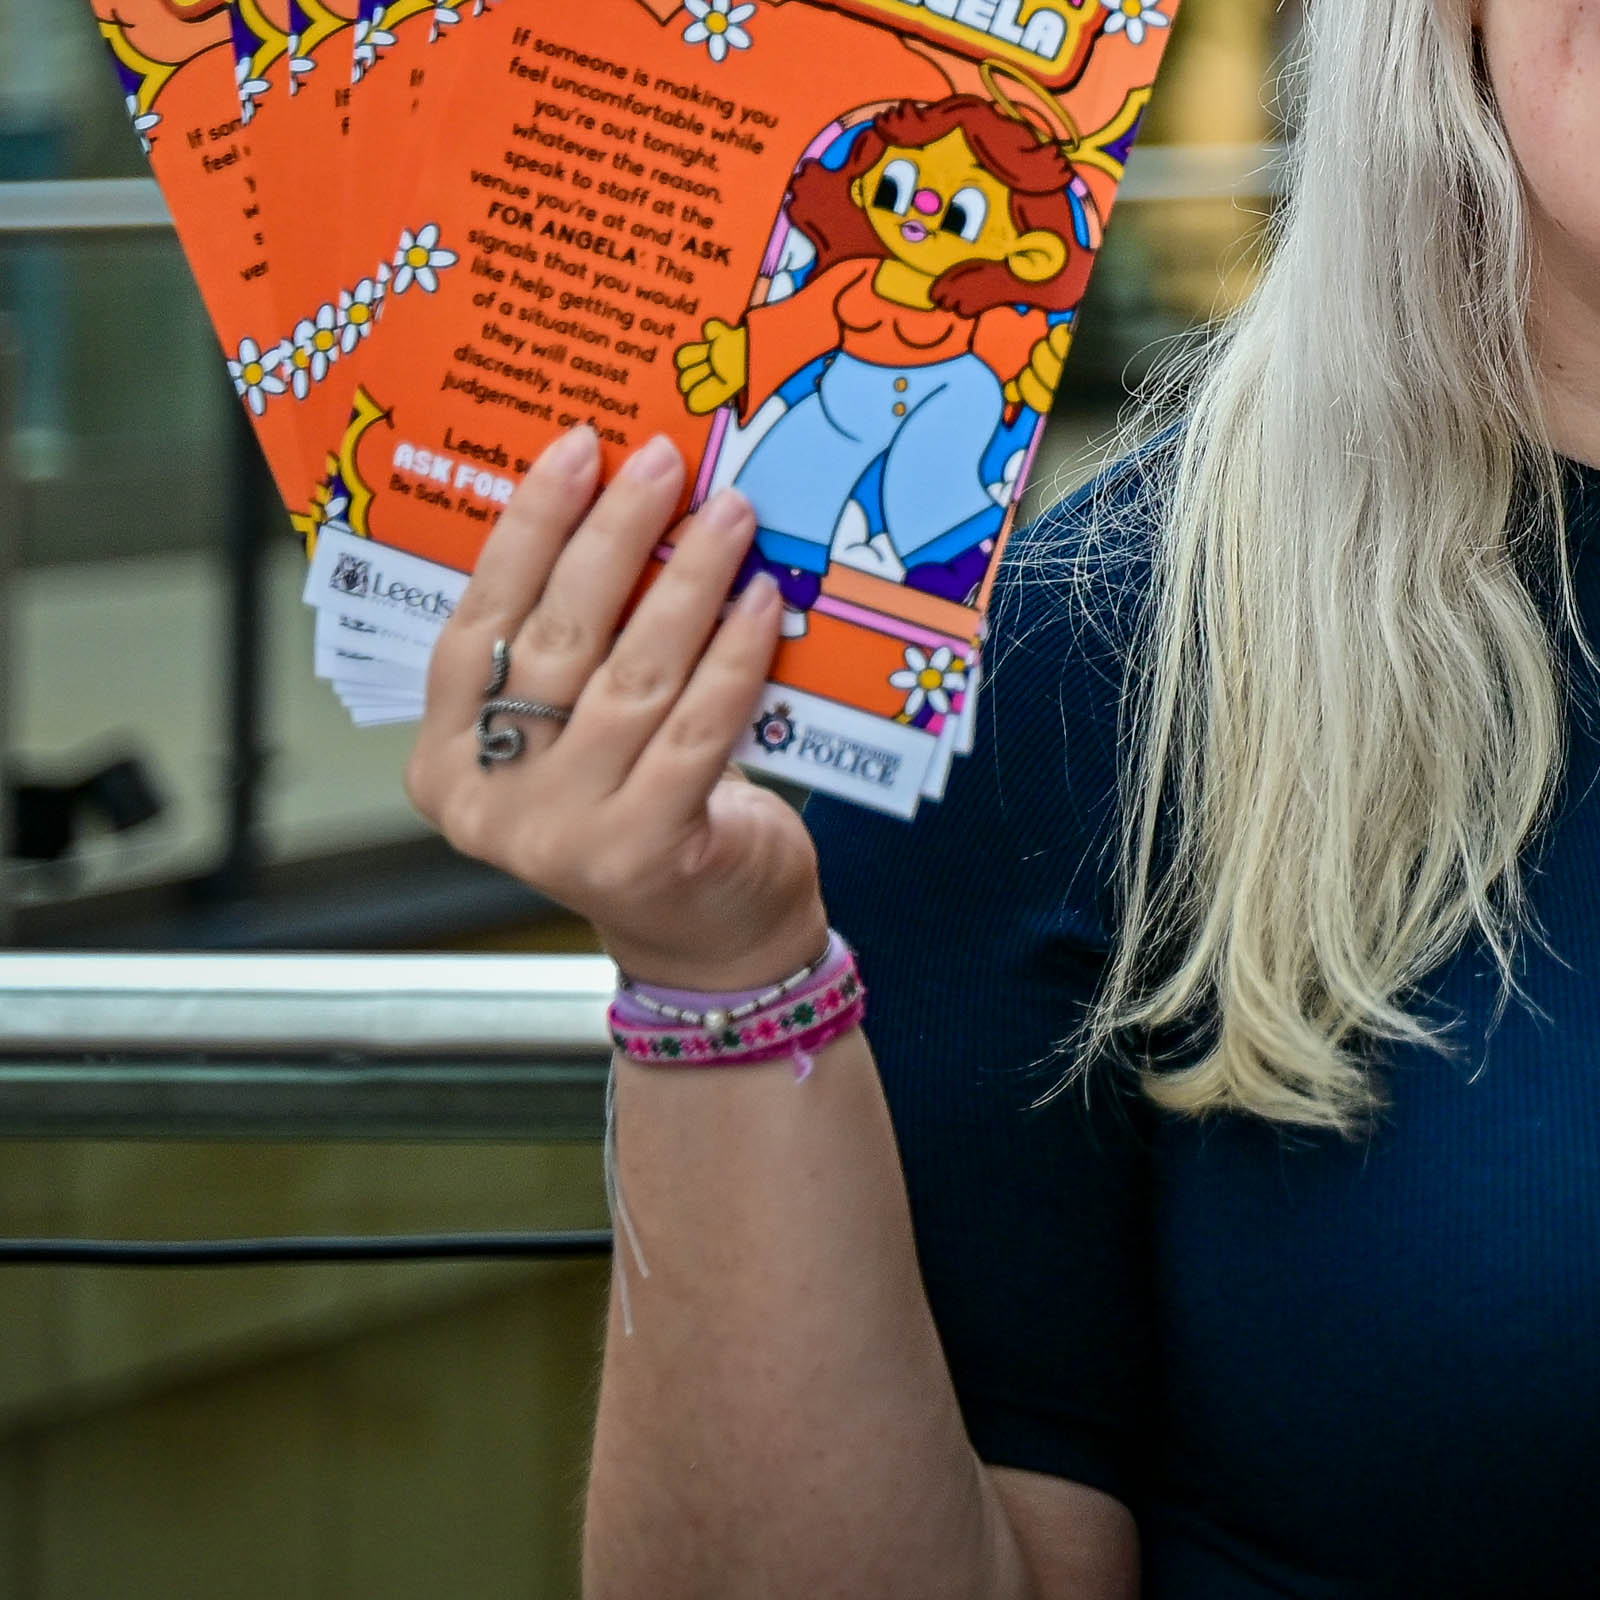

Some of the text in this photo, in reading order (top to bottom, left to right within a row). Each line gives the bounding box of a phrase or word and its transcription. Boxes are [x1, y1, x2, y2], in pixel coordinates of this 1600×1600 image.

[509, 56, 765, 155] feel uncomfortable while
[512, 26, 779, 130] If someone is making you
[512, 123, 607, 163] whatever
[612, 152, 645, 177] the
[533, 100, 596, 130] you're
[601, 121, 637, 144] out
[202, 145, 239, 173] feel
[504, 151, 714, 230] speak to staff at the
[470, 169, 530, 199] venue
[535, 191, 597, 222] you're
[602, 211, 626, 231] at
[630, 222, 673, 246] and
[467, 228, 699, 316] signals that you would
[487, 201, 534, 231] FOR
[655, 254, 695, 285] This
[470, 256, 676, 339] like help getting out
[472, 291, 657, 363] of a situation and
[481, 322, 629, 385] they will assist
[441, 370, 554, 421] judgement
[559, 383, 639, 419] without
[392, 442, 454, 484] ASK
[454, 464, 515, 505] FOR
[443, 427, 509, 469] Leeds
[389, 473, 410, 494] Be
[372, 572, 456, 620] Leeds
[798, 737, 896, 787] POLICE
